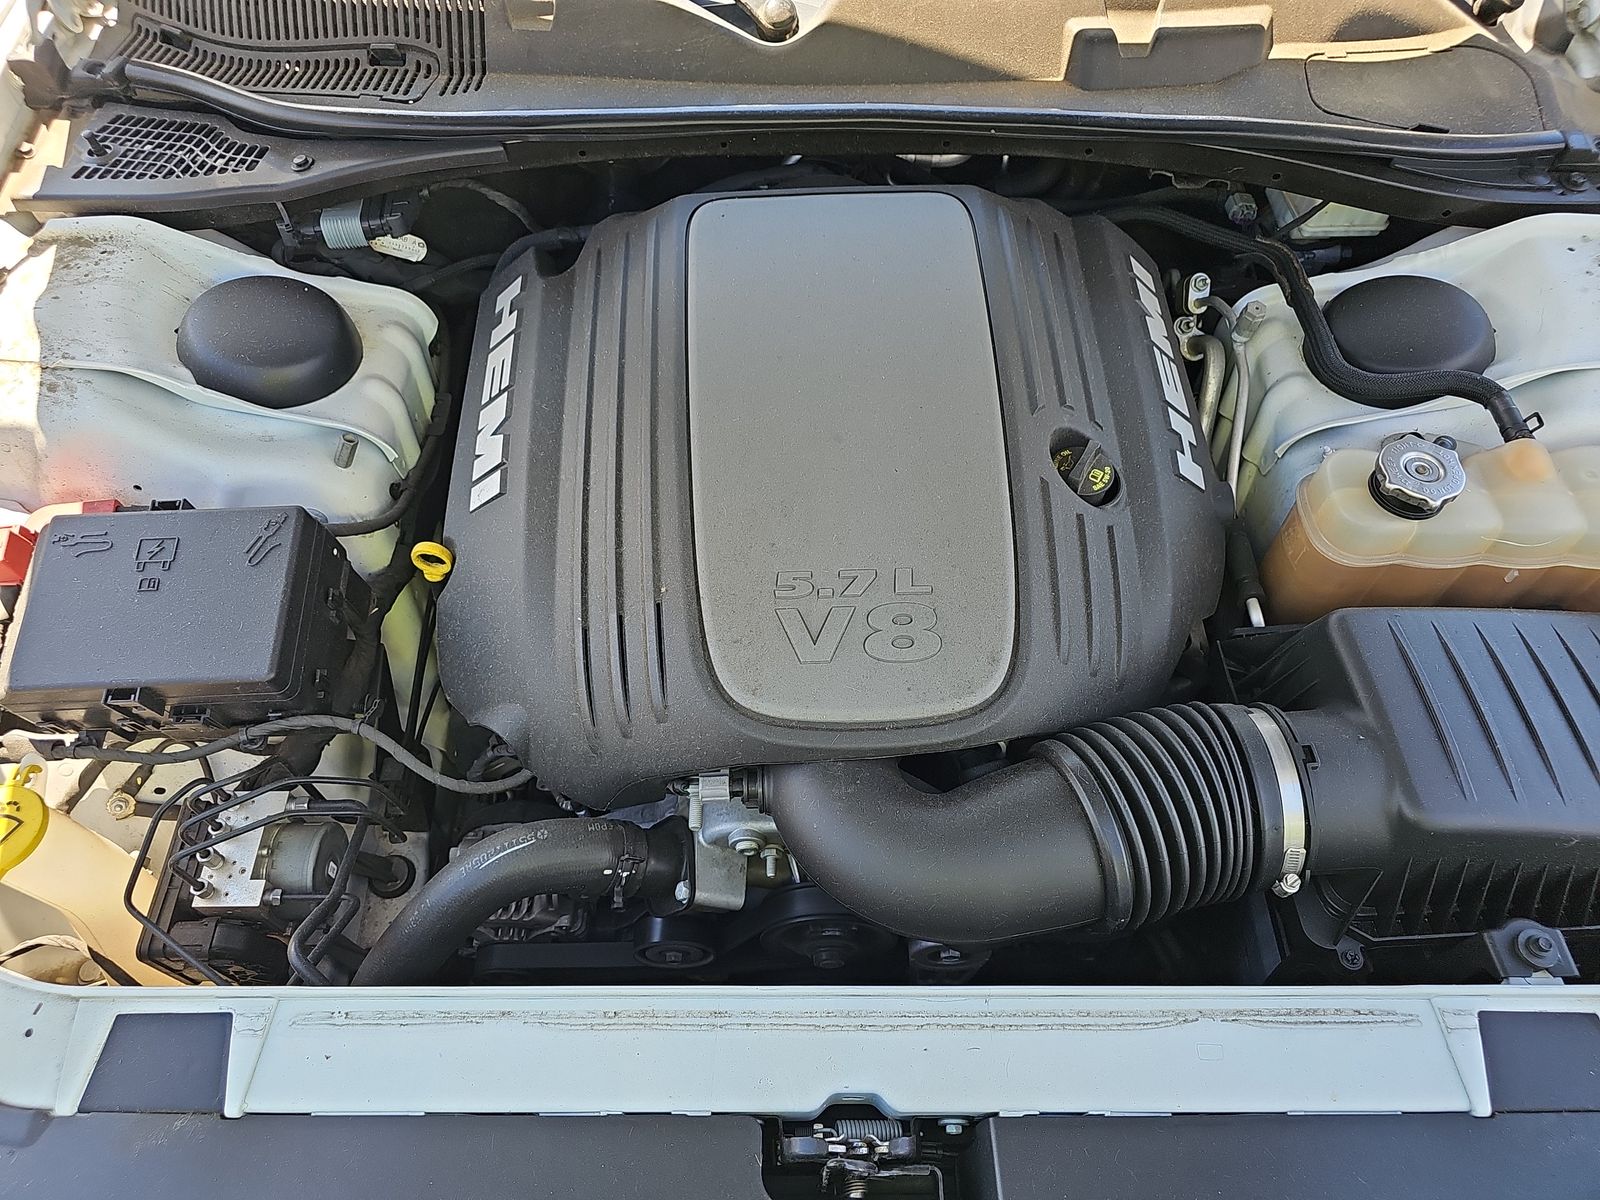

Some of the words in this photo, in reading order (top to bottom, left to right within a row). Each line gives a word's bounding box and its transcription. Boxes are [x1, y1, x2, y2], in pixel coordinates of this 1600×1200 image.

[470, 275, 522, 513] HEMI
[1129, 254, 1206, 491] HEMI
[1060, 449, 1073, 457] OIL
[773, 568, 878, 600] 5.7
[894, 567, 934, 596] L
[774, 601, 943, 665] V8
